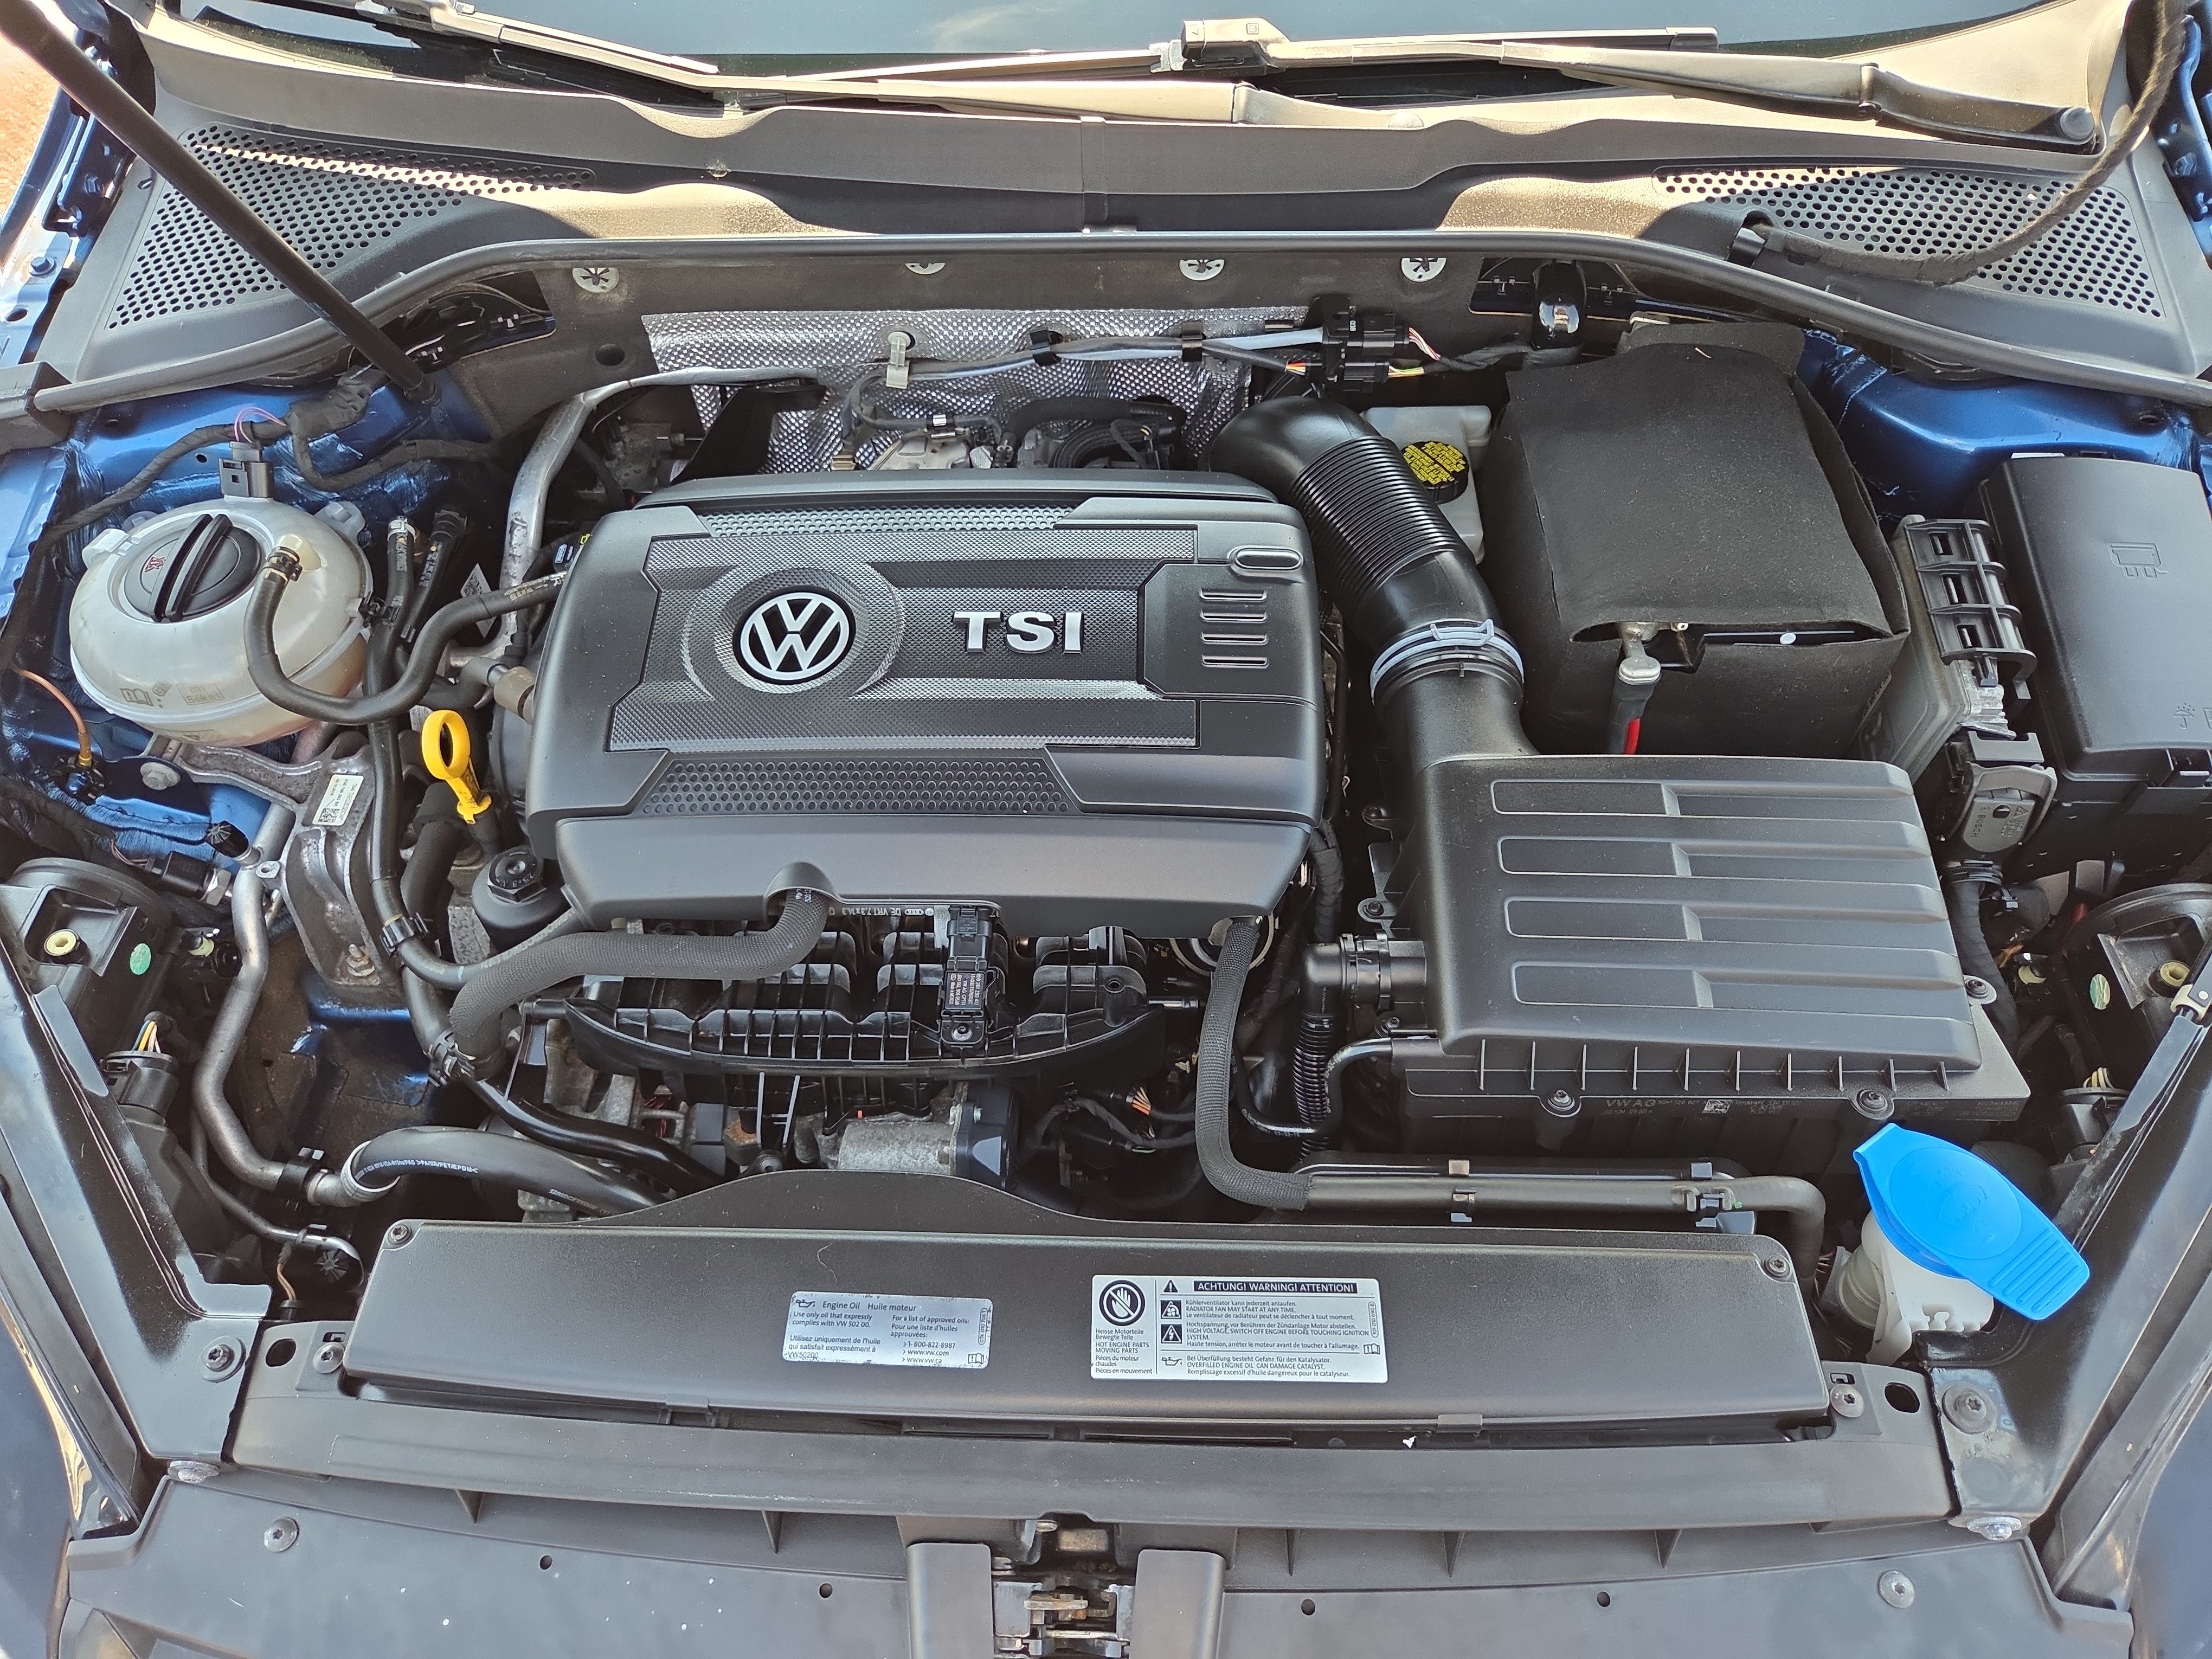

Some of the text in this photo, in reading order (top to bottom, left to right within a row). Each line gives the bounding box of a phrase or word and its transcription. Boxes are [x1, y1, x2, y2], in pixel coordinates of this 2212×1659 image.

[953, 610, 1084, 654] TSI
[1198, 1282, 1353, 1293] ACHTUNG! WARNING! ATTENTION!
[822, 1301, 848, 1310] Engine
[806, 1311, 820, 1320] only
[844, 1313, 873, 1321] expressly
[927, 1316, 956, 1325] approved
[814, 1336, 851, 1345] uniquement
[1197, 1354, 1231, 1362] Überfüllung
